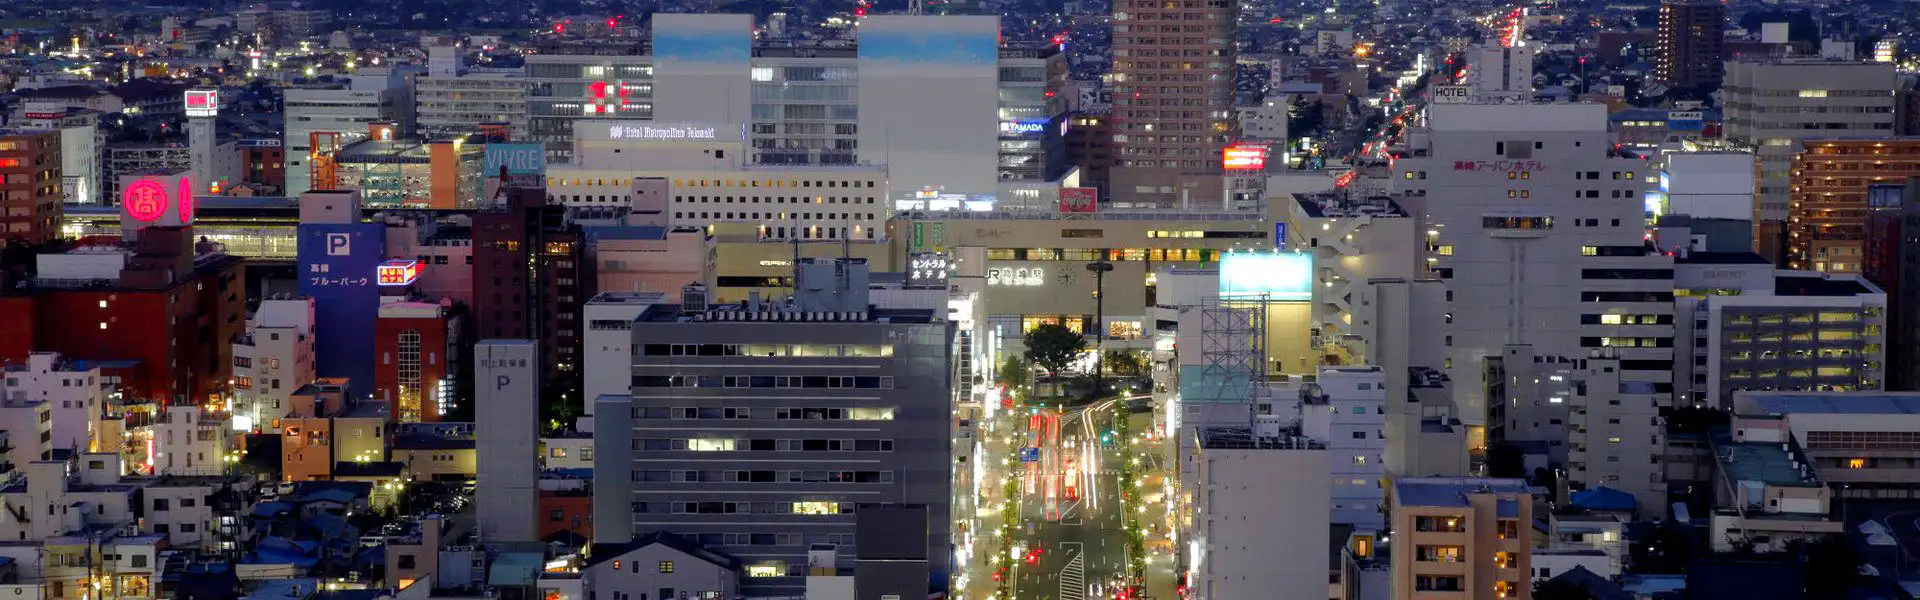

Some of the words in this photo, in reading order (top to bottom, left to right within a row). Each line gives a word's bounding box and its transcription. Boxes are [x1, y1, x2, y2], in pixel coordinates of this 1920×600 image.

[625, 126, 642, 138] Hotel
[643, 126, 685, 140] Metropolitan
[687, 126, 715, 138] Takasaki
[1009, 123, 1043, 132] YAMADA
[484, 149, 538, 170] VIVRE
[329, 235, 347, 254] P
[311, 263, 329, 272] 高崎
[912, 259, 947, 269] セントラル
[912, 270, 947, 280] ホテル
[497, 375, 511, 391] P
